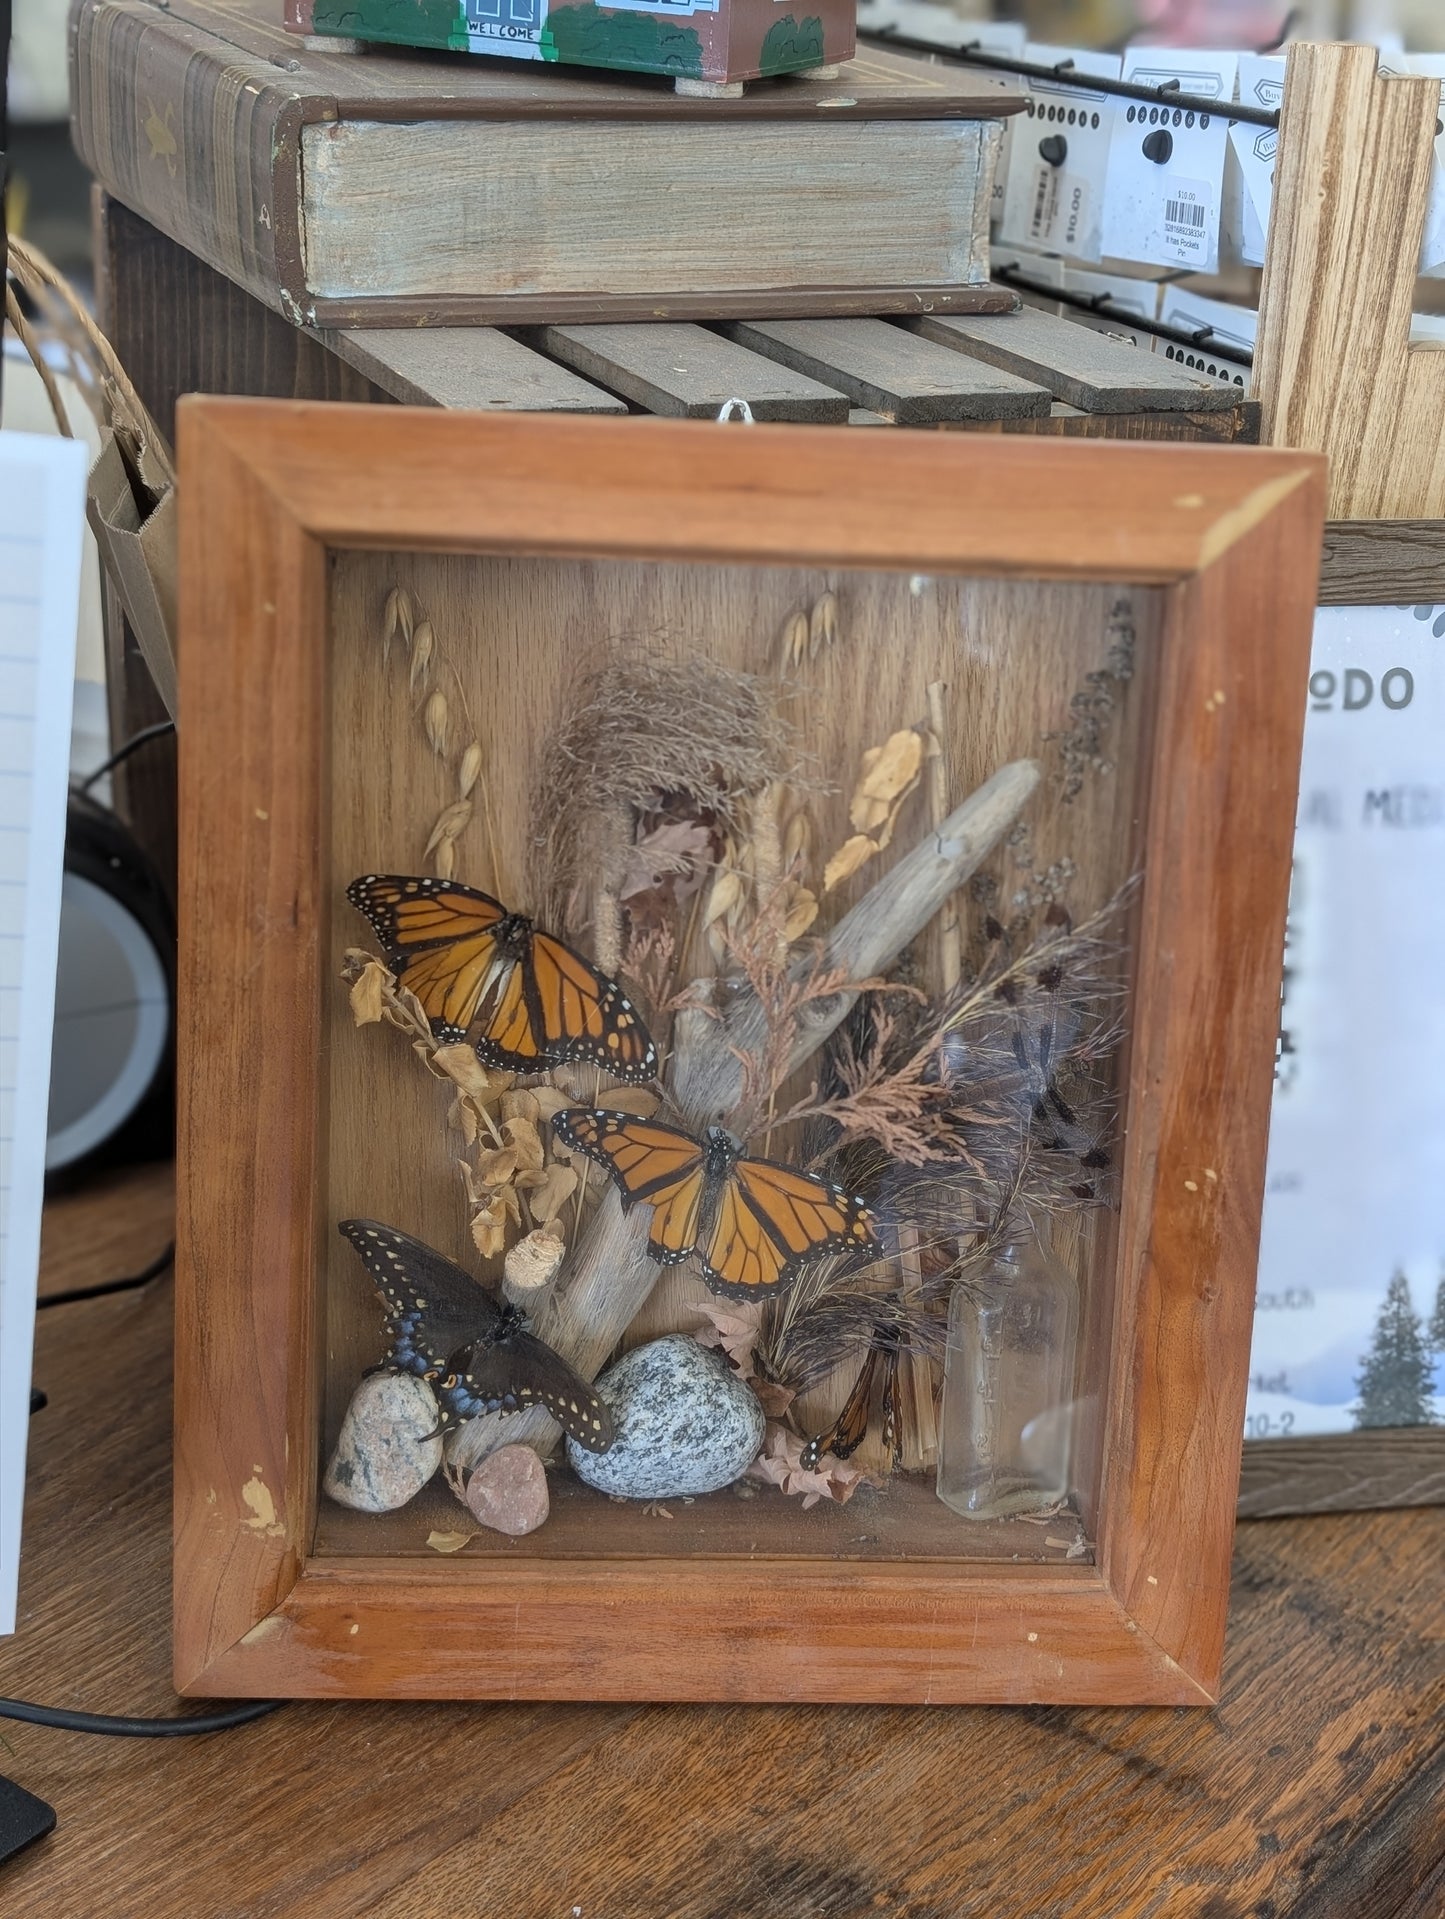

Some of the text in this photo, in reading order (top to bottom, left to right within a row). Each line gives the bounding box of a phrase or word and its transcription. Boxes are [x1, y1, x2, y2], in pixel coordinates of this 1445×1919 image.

[468, 21, 534, 40] WELCOME
[1178, 190, 1196, 201] $10.00
[1065, 187, 1081, 243] $10.00
[1180, 238, 1199, 250] Pockets
